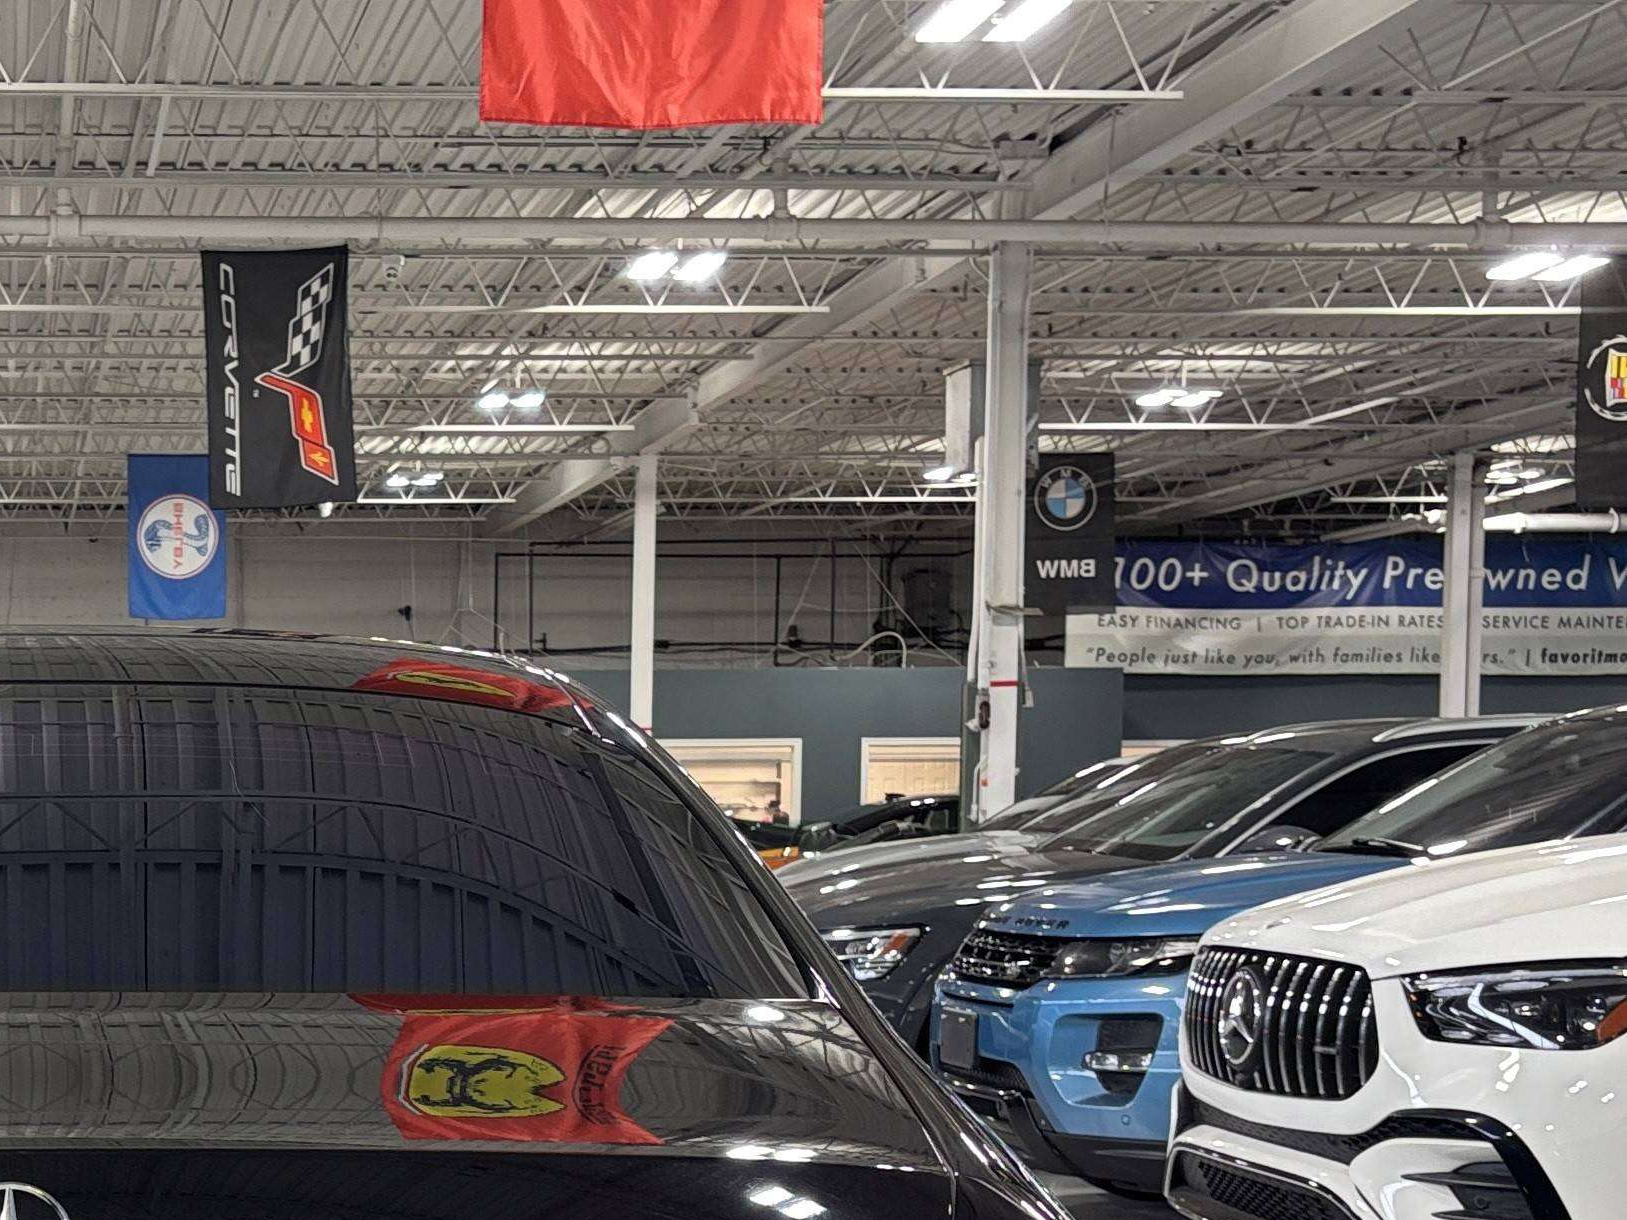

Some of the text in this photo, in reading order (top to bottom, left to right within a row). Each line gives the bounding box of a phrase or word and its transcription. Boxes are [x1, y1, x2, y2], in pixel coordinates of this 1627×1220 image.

[219, 262, 242, 497] CORVETTE
[1114, 557, 1209, 591] 100+
[1226, 555, 1368, 601] Quality
[1097, 614, 1627, 631] EASY FINANCING TOP TRADE-IN RATES SERVICE MAINTE
[1164, 647, 1198, 667] just
[1204, 647, 1236, 664] like
[1289, 647, 1325, 664] with
[1332, 646, 1403, 664] families
[1410, 646, 1441, 663] like
